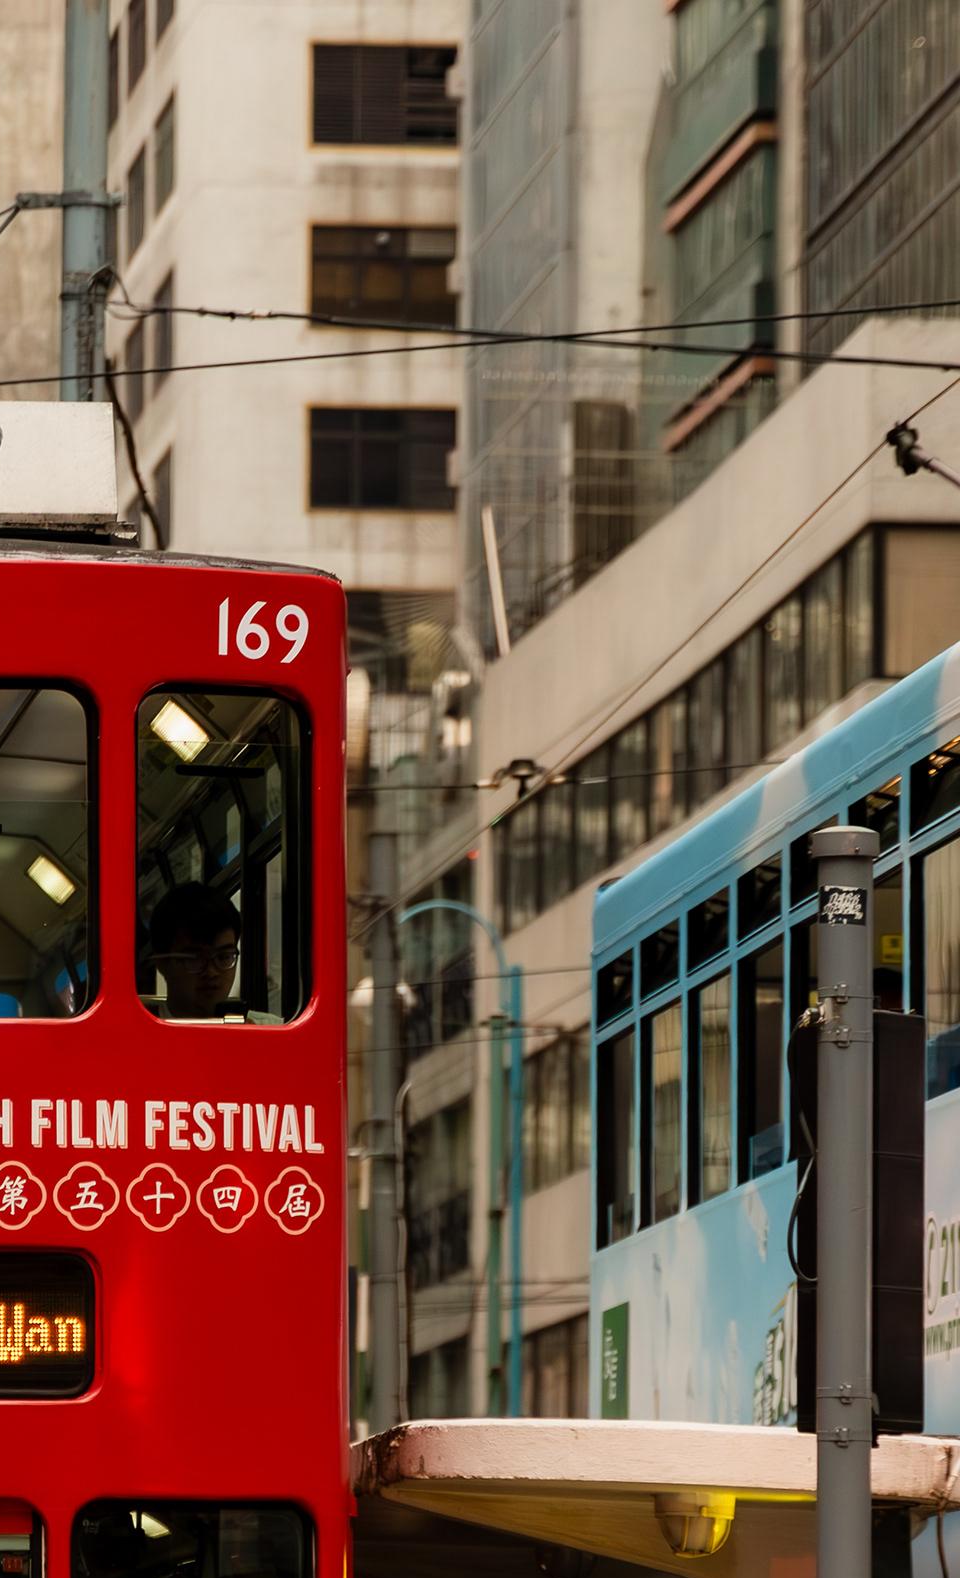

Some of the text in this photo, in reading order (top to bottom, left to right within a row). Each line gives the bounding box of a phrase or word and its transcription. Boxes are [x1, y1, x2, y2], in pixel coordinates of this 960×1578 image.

[217, 596, 310, 664] 169
[30, 1098, 128, 1149] FILM
[144, 1101, 325, 1154] FESTIVAL
